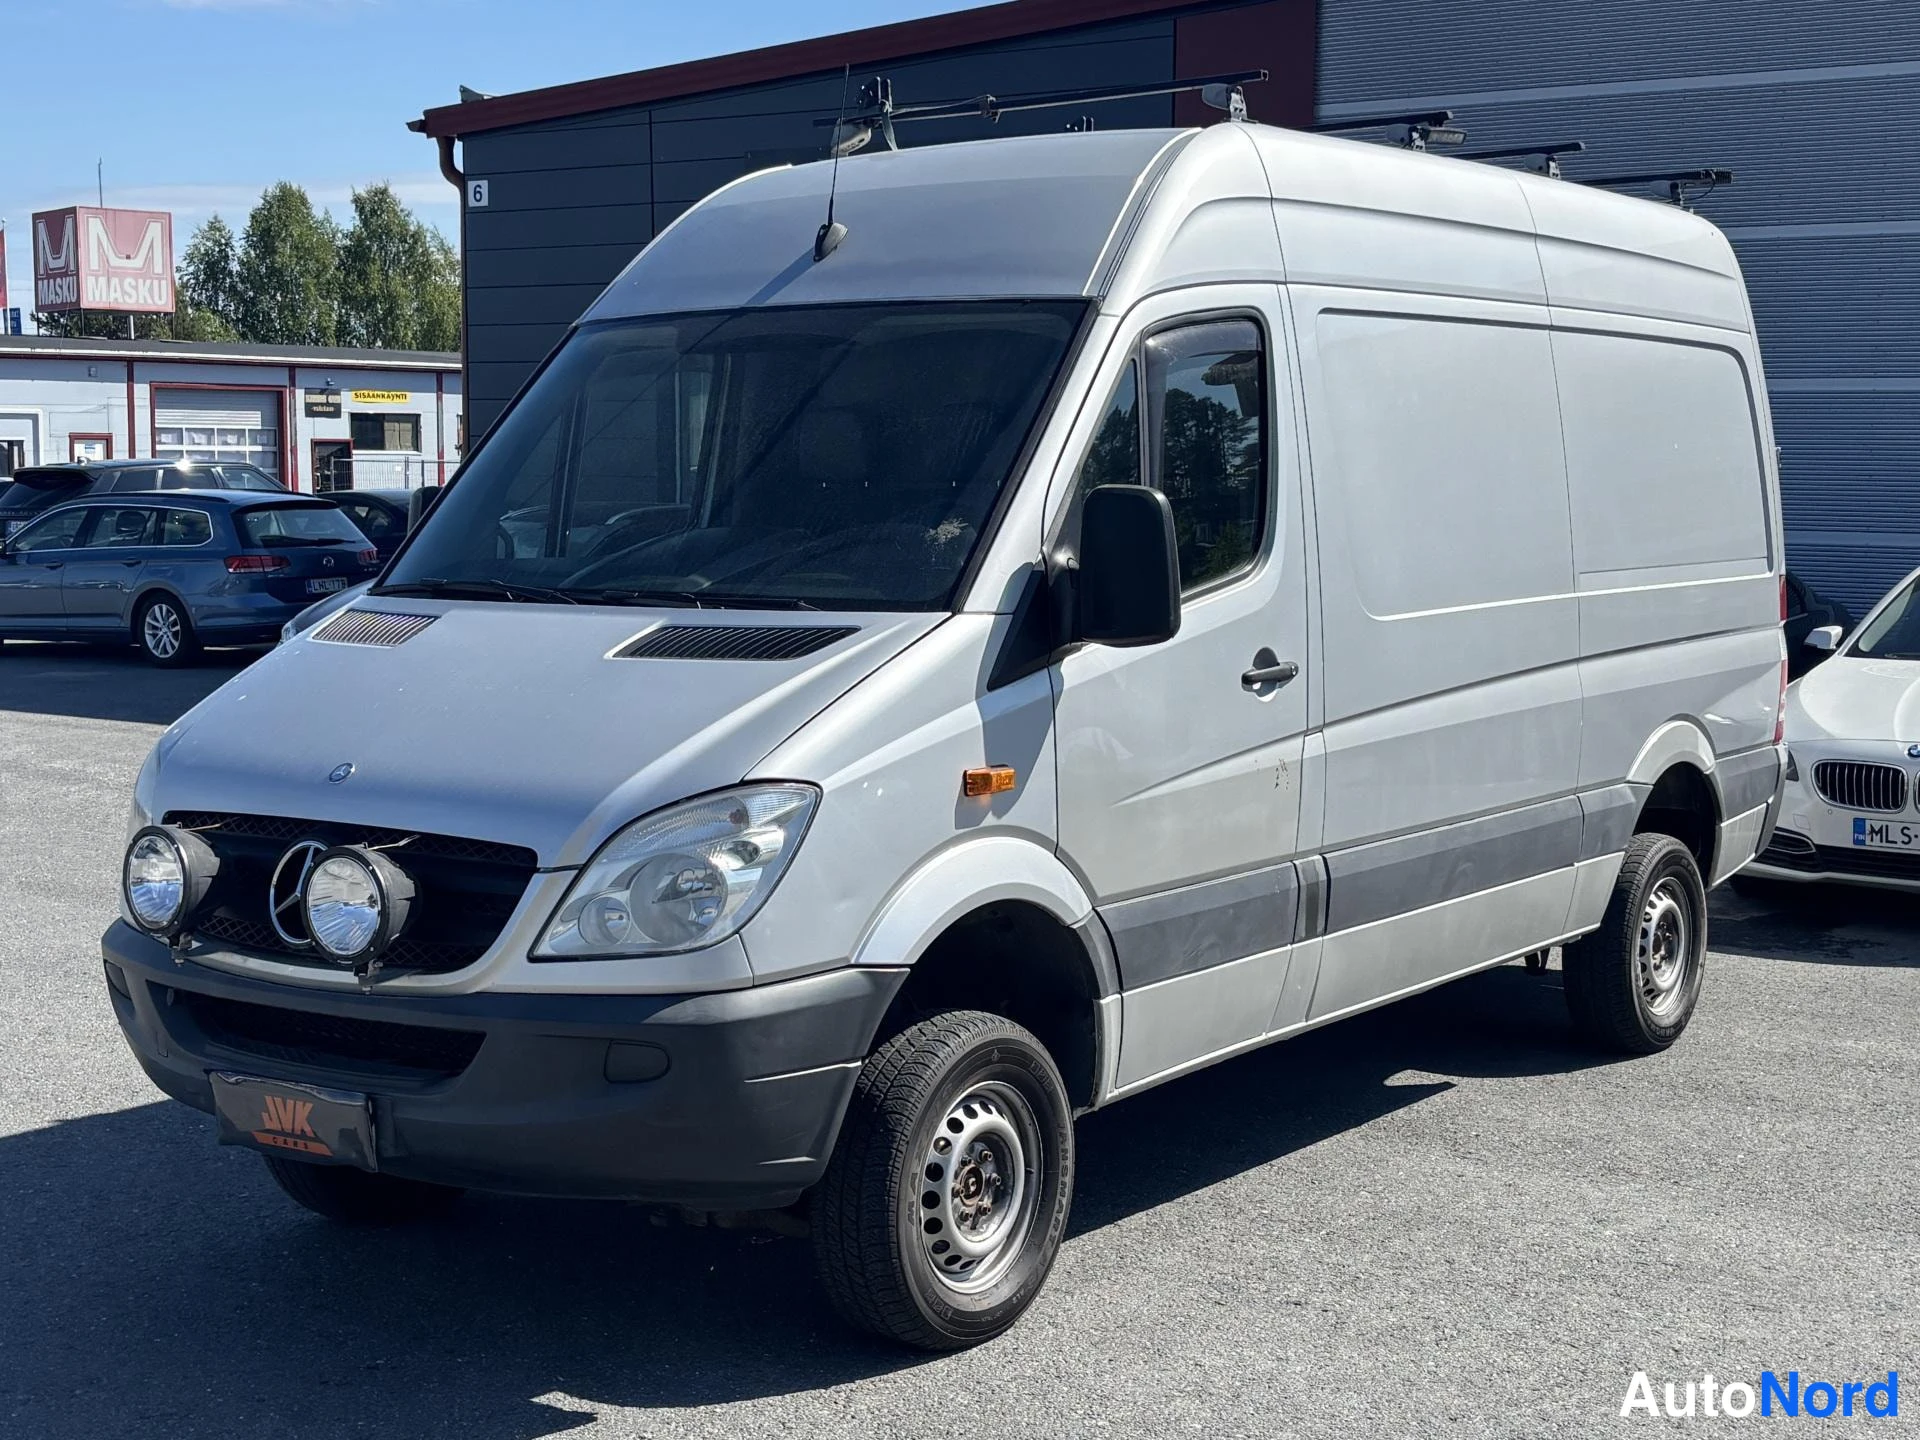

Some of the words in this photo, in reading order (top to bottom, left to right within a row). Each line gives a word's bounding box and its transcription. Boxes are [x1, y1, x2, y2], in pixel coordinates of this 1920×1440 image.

[473, 184, 482, 202] 6
[38, 276, 77, 305] MASKU
[86, 275, 168, 305] MASKU
[261, 1095, 317, 1138] JVK
[272, 1137, 308, 1149] CARS
